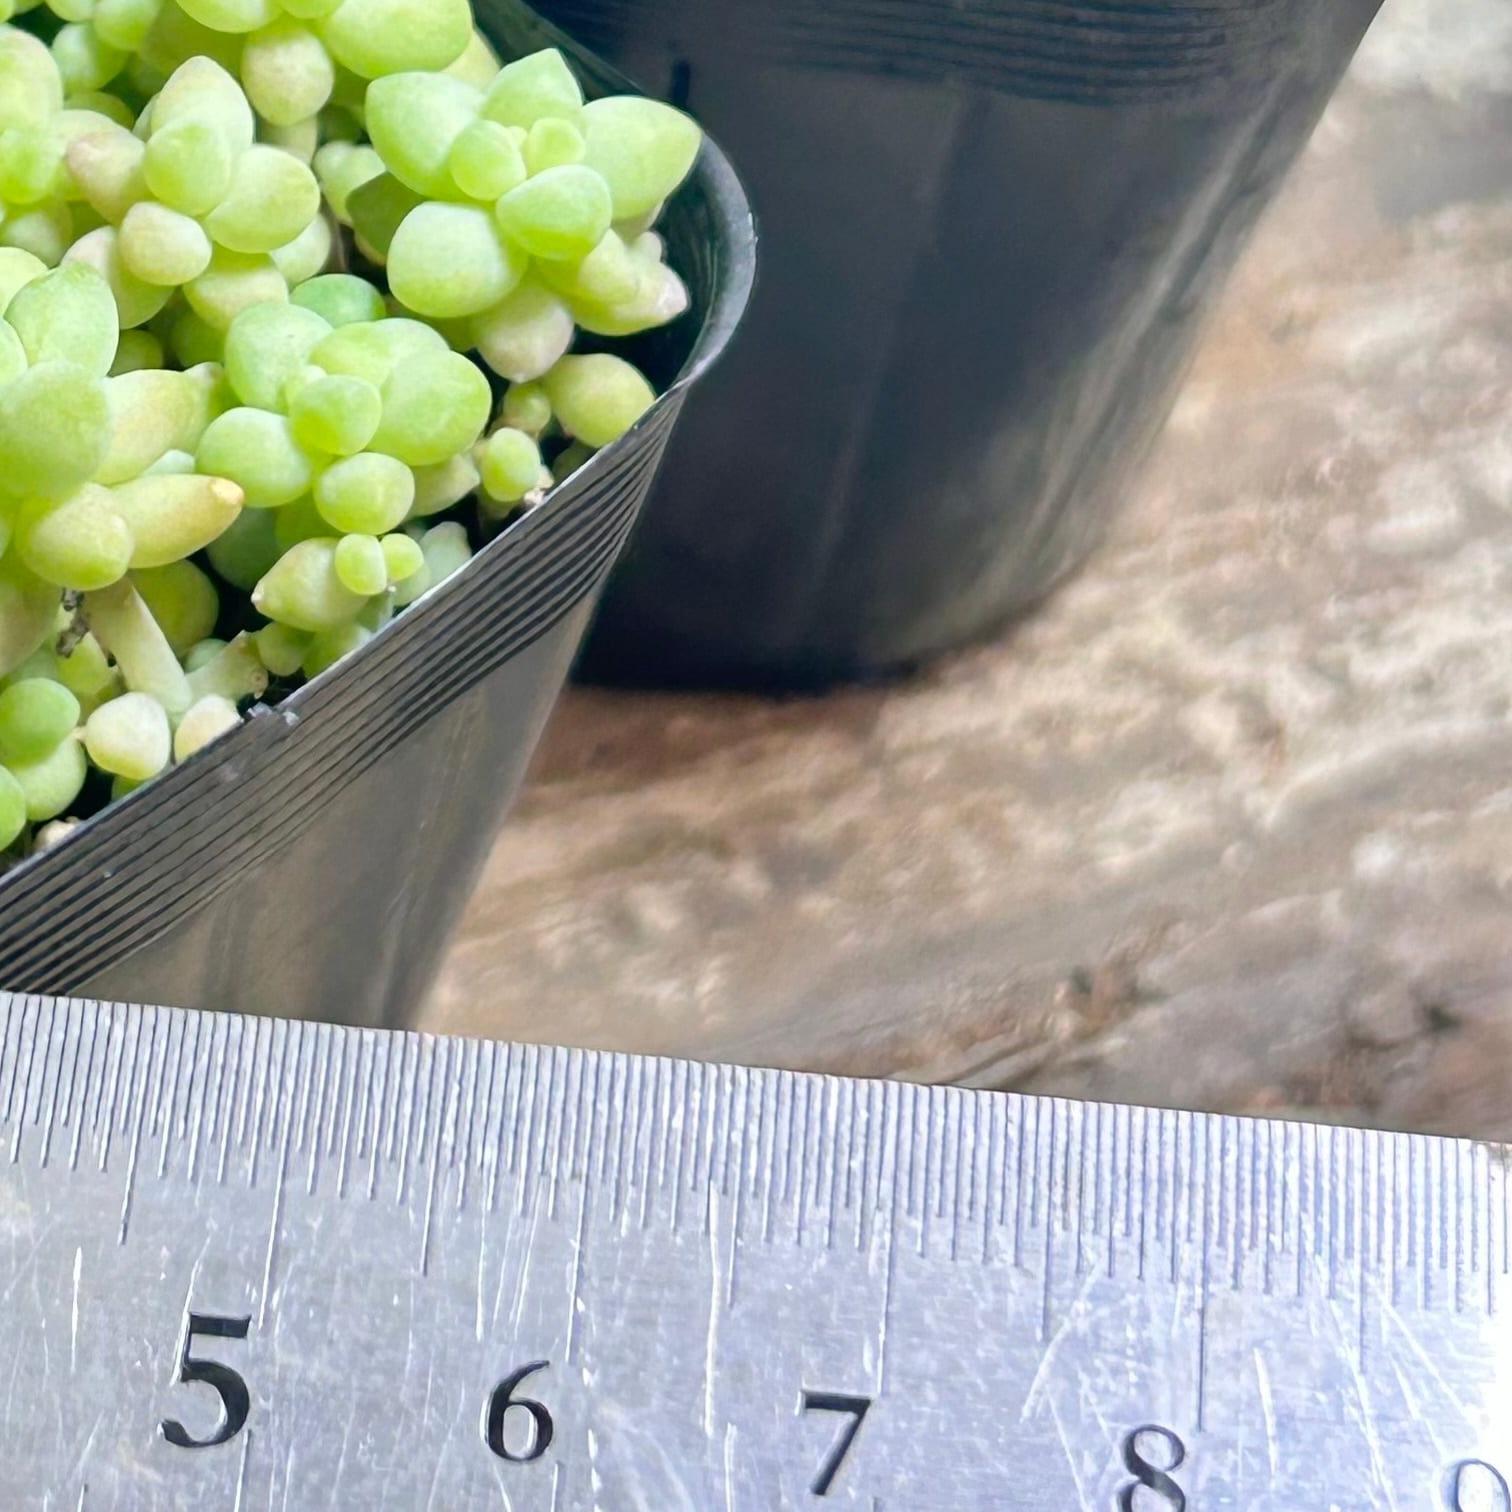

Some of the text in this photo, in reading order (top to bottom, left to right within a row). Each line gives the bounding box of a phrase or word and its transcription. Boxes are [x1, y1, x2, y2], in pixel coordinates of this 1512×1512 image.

[158, 1310, 253, 1449] 5
[485, 1359, 554, 1463] 6
[799, 1389, 872, 1496] 7
[1118, 1424, 1187, 1512] 8
